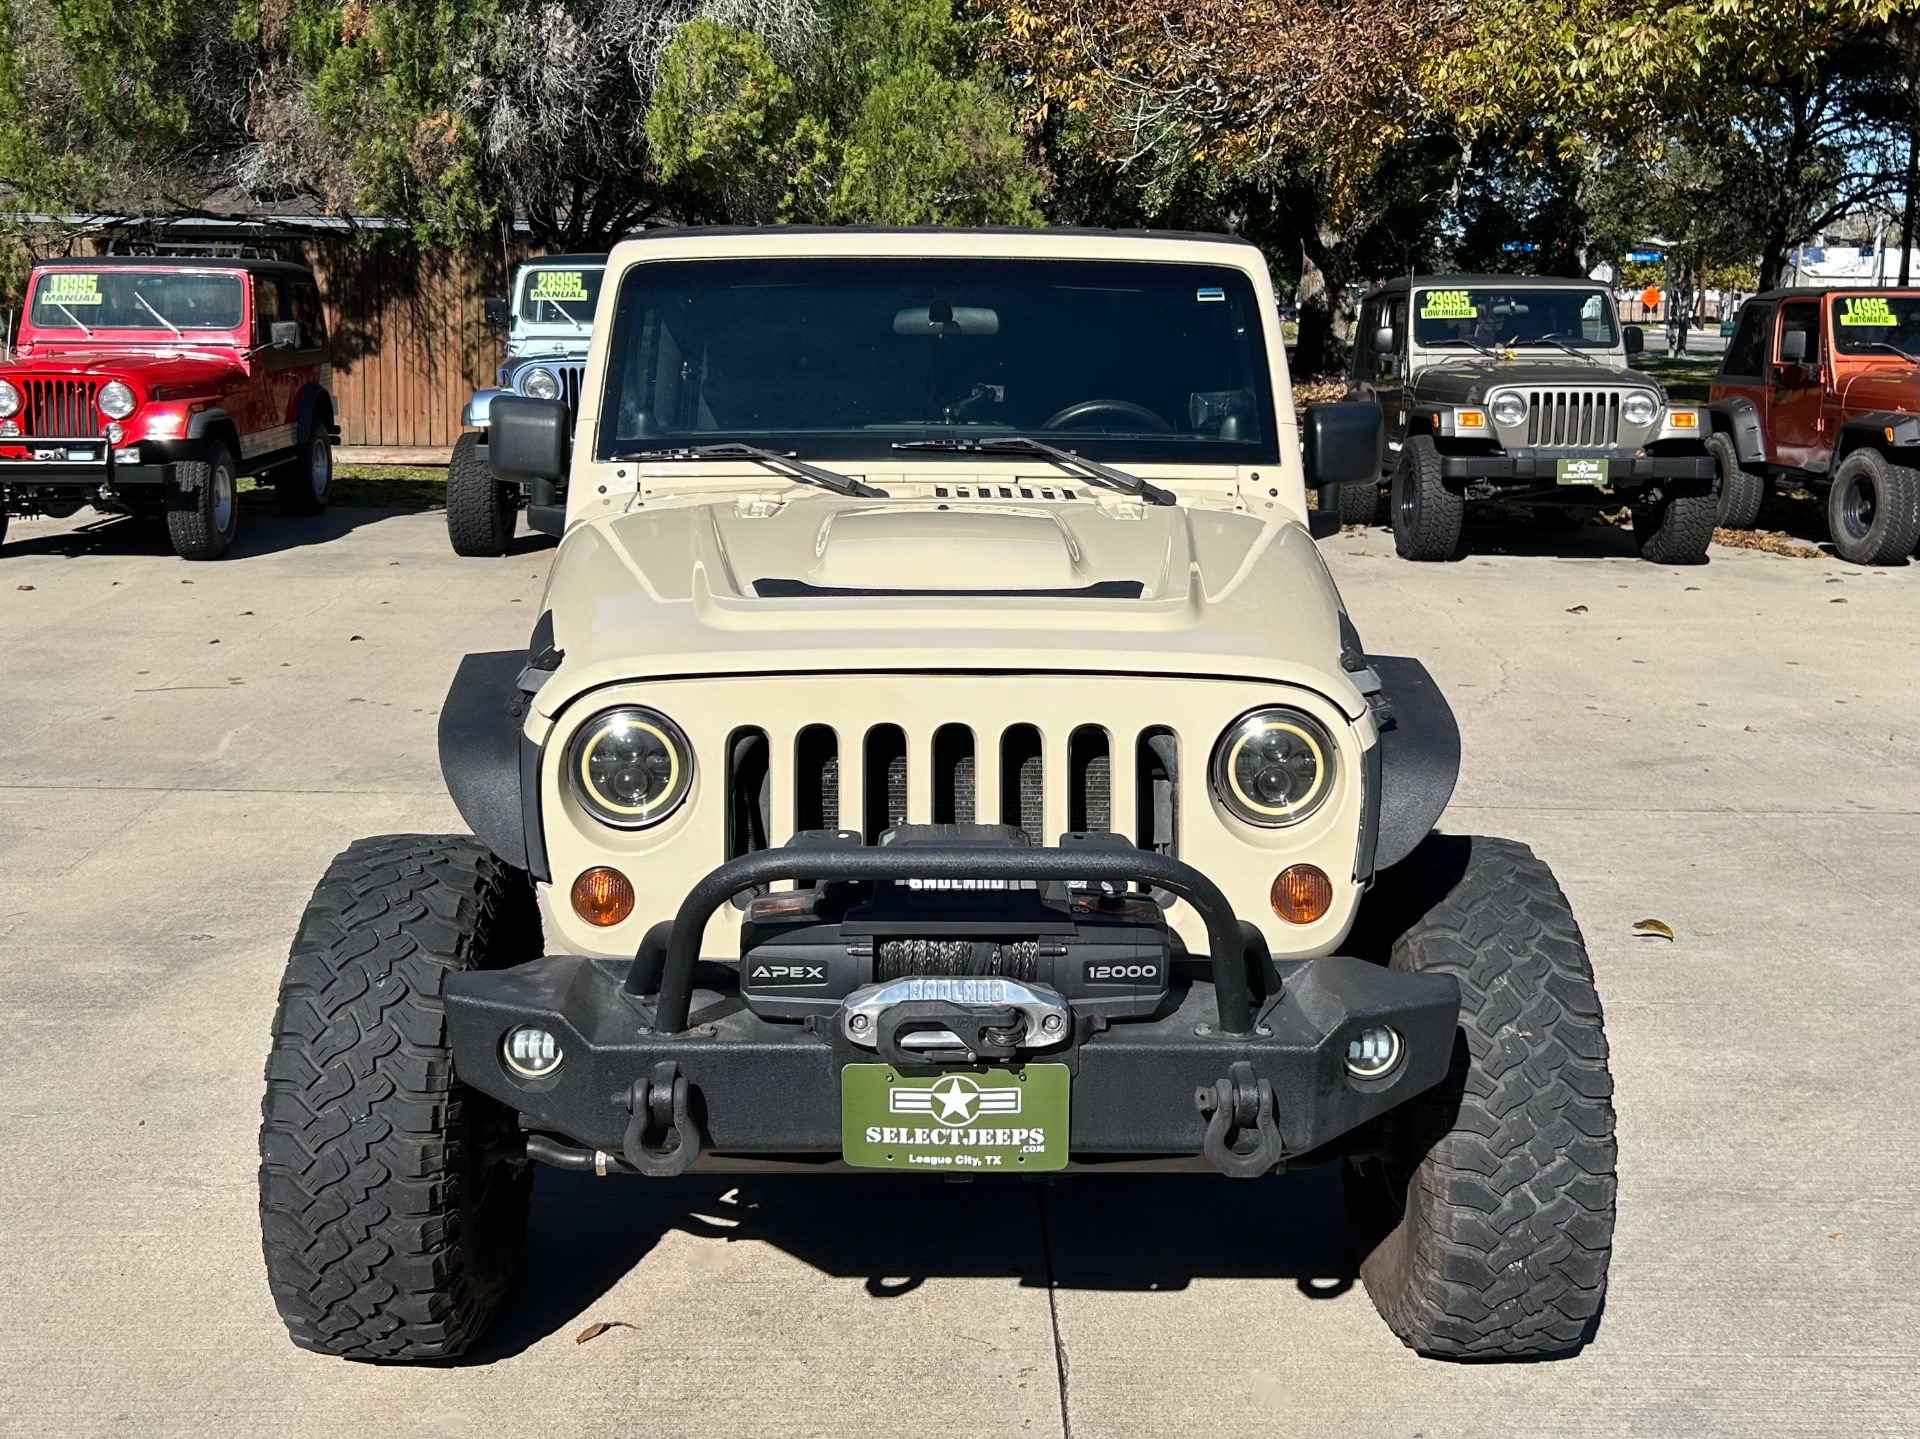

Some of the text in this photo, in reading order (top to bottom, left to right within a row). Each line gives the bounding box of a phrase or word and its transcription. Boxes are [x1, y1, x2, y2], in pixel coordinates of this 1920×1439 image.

[51, 274, 98, 293] 18995
[538, 272, 582, 290] 28995
[45, 294, 99, 302] MANUAL
[533, 291, 584, 299] MANUAL
[1426, 291, 1470, 309] 29995
[1424, 308, 1473, 317] LOW MILEAGE
[1845, 298, 1889, 316] 14995
[1849, 316, 1890, 324] AUTOMATIC
[751, 965, 824, 979] APEX
[1088, 965, 1157, 979] 12000
[908, 980, 1006, 1003] BADLAND
[865, 1126, 1045, 1146] SELECTJEEPS
[1019, 1145, 1045, 1153] .COM
[908, 1153, 1002, 1167] League City, TX
